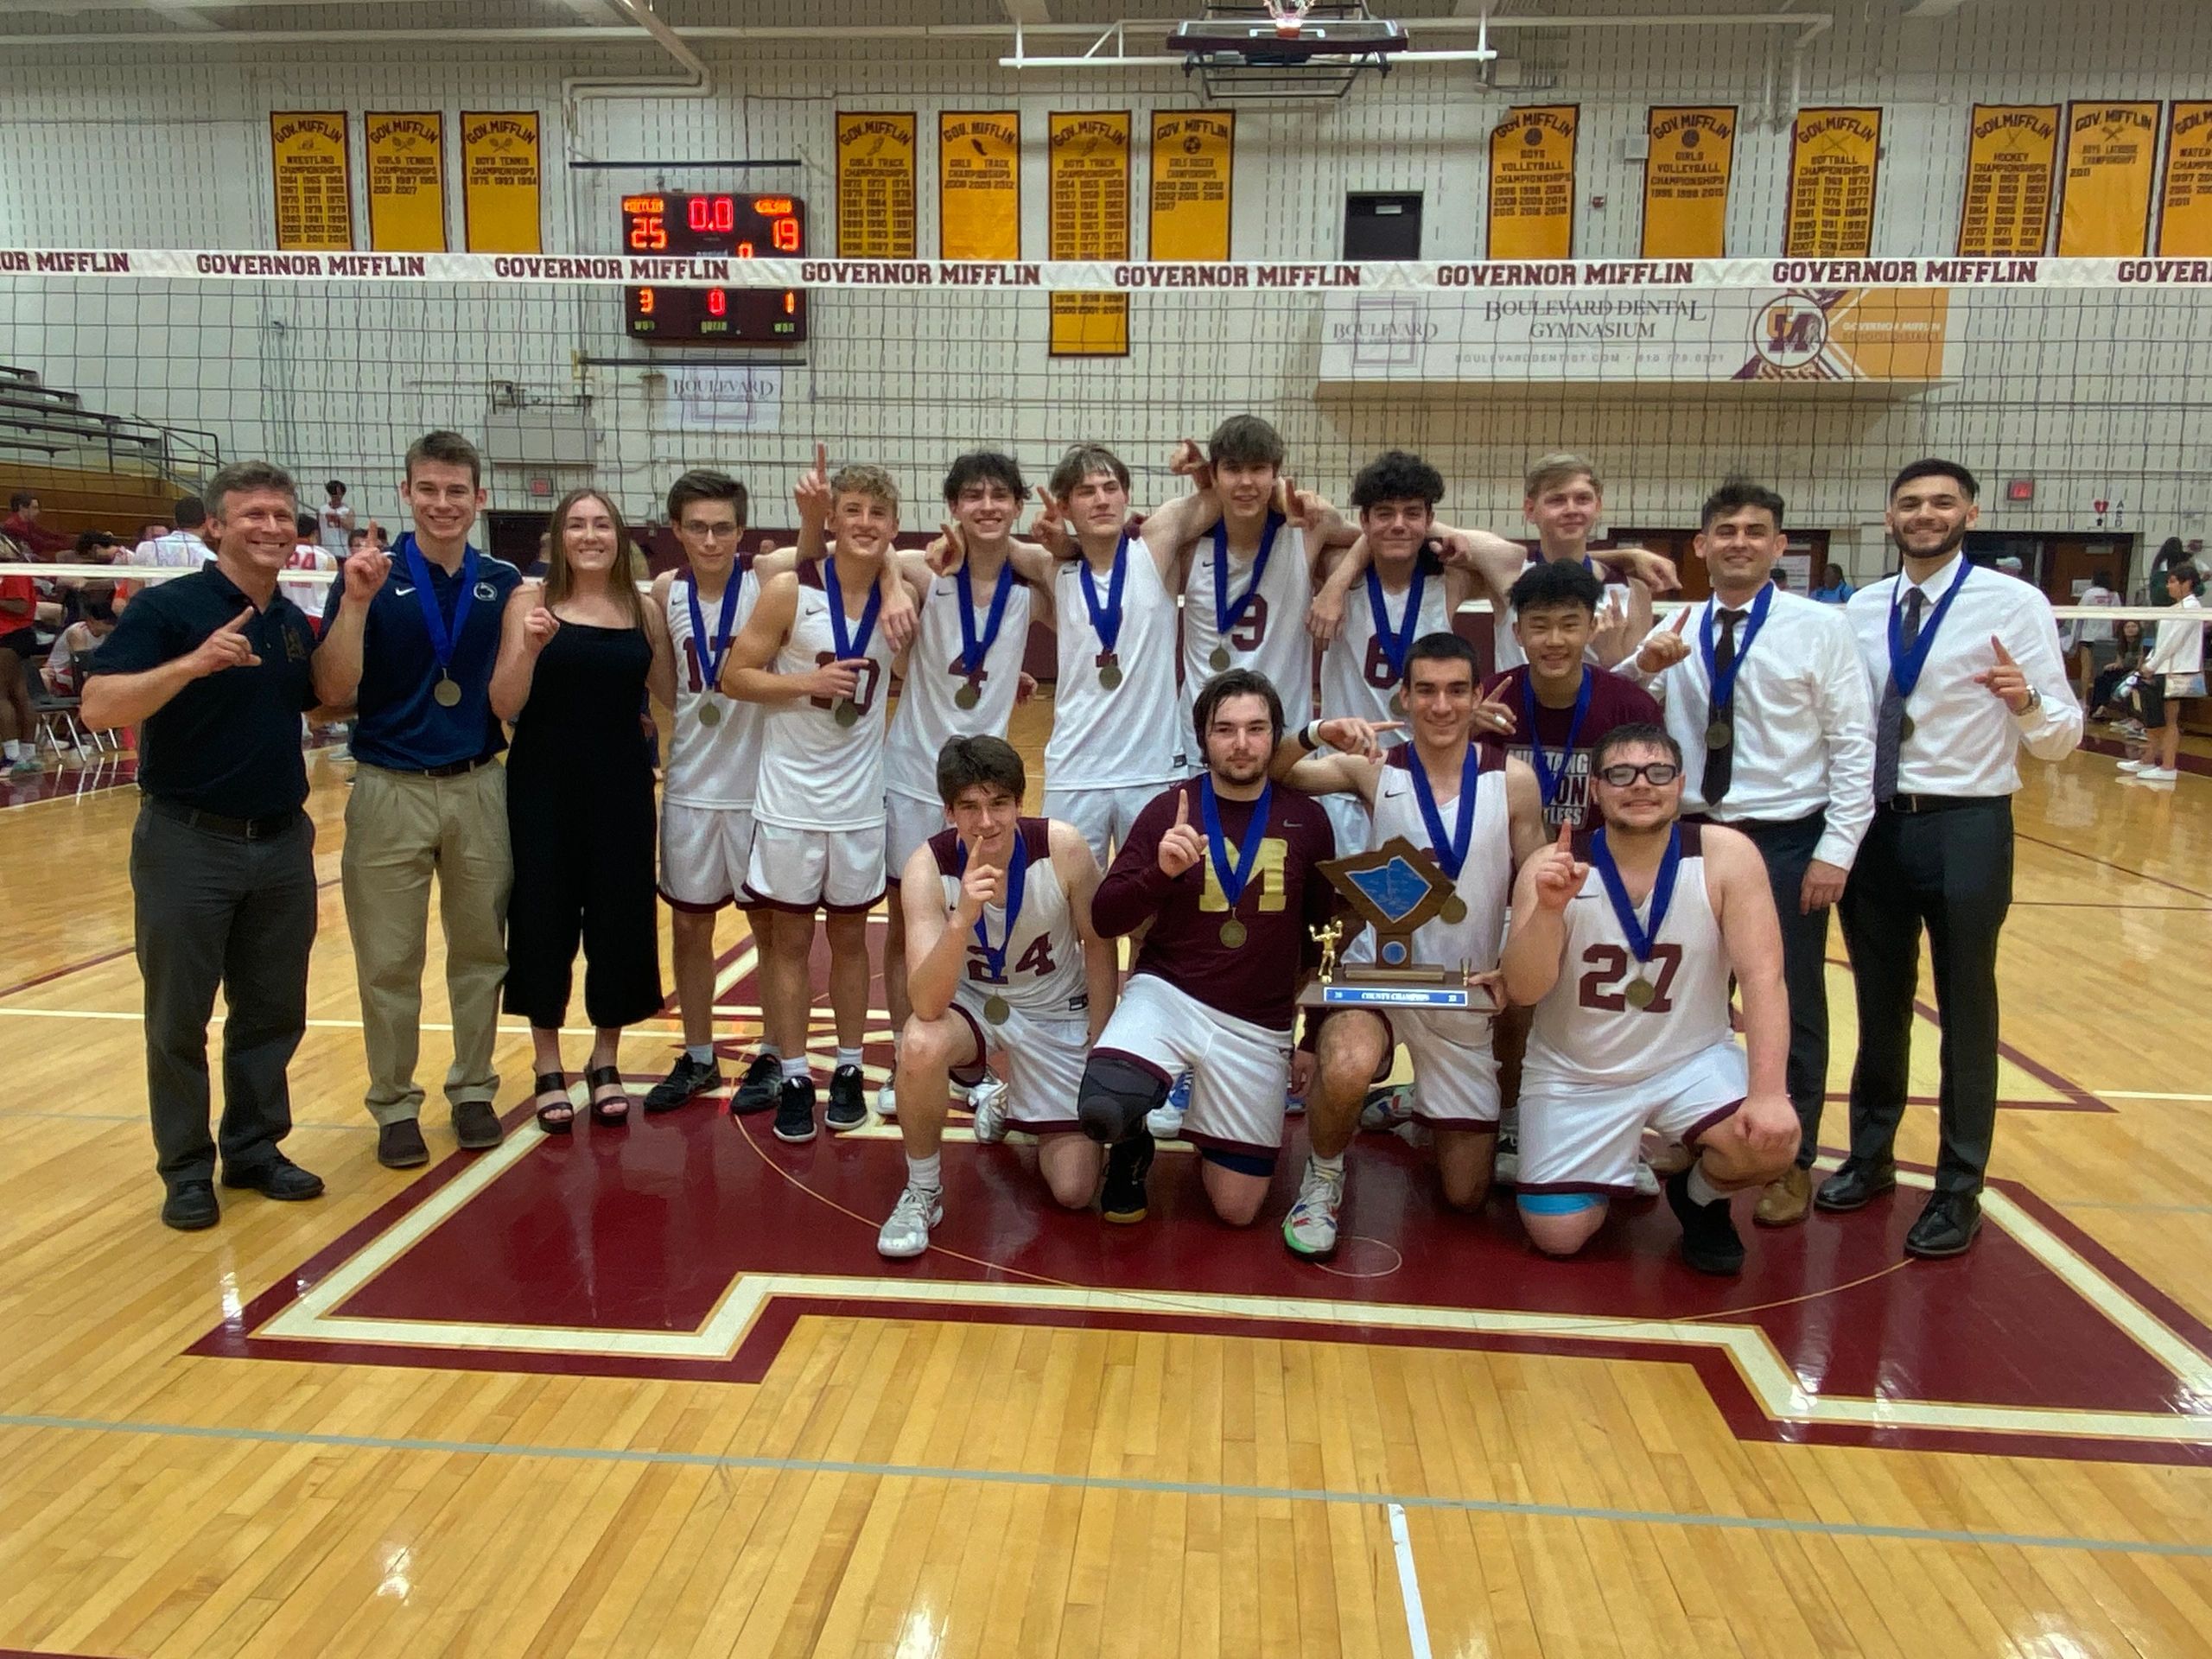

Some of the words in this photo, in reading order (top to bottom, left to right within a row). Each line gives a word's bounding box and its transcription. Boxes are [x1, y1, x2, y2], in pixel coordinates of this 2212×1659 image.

[1185, 119, 1228, 139] MIFFLIN
[1522, 113, 1573, 138] MIFFLIN
[1681, 115, 1730, 139] MIFFLIN
[1826, 118, 1875, 142] MIFFLIN
[2003, 113, 2054, 140] MIFFLIN
[2105, 110, 2152, 130] MIFFLIN
[298, 120, 343, 143] MIFFLIN
[393, 119, 438, 144] MIFFLIN
[490, 120, 535, 145] MIFFLIN
[865, 121, 912, 146] MIFFLIN
[971, 122, 1015, 144] MIFFLIN
[1078, 121, 1126, 146] MIFFLIN
[1521, 149, 1546, 159] BOYS
[1675, 151, 1704, 161] GIRLS
[1811, 156, 1858, 164] SOFTBALL
[1993, 152, 2029, 162] HOCKEY
[1501, 161, 1564, 172] VOLLEYBALL
[1657, 163, 1721, 173] VOLLEYBALL
[1800, 165, 1869, 175] CHAMPIONSHIPS
[1974, 163, 2047, 173] CHAMPIONSHIPS
[1495, 173, 1571, 184] CHAMPIONSHIPS
[1650, 175, 1725, 186] CHAMPIONSHIPS
[632, 217, 667, 249] 25
[773, 217, 798, 251] 19
[35, 251, 130, 272] MIFFLIN
[196, 255, 322, 276] GOVERNOR
[327, 257, 425, 276] MIFFLIN
[494, 257, 624, 279] GOVERNOR
[631, 259, 729, 281] MIFFLIN
[1772, 261, 1917, 283] GOVERNOR
[1924, 261, 2037, 283] MIFFLIN
[2118, 261, 2212, 283] GOVER
[801, 262, 932, 283] GOVERNOR
[939, 263, 1040, 285] MIFFLIN
[1115, 265, 1249, 287] GOVERNOR
[1257, 265, 1361, 287] MIFFLIN
[1437, 264, 1577, 287] GOVERNOR
[1584, 262, 1694, 285] MIFFLIN
[639, 287, 653, 314] 3
[709, 288, 726, 315] 0
[785, 290, 795, 315] 1
[1484, 300, 1614, 322] BOULEVARD
[1616, 299, 1707, 322] DENTAL
[1530, 321, 1656, 340] GYMNASIUM
[1230, 594, 1268, 652] 9
[1198, 837, 1287, 912] M
[967, 932, 1057, 985] 24
[1580, 944, 1683, 1014] 27
